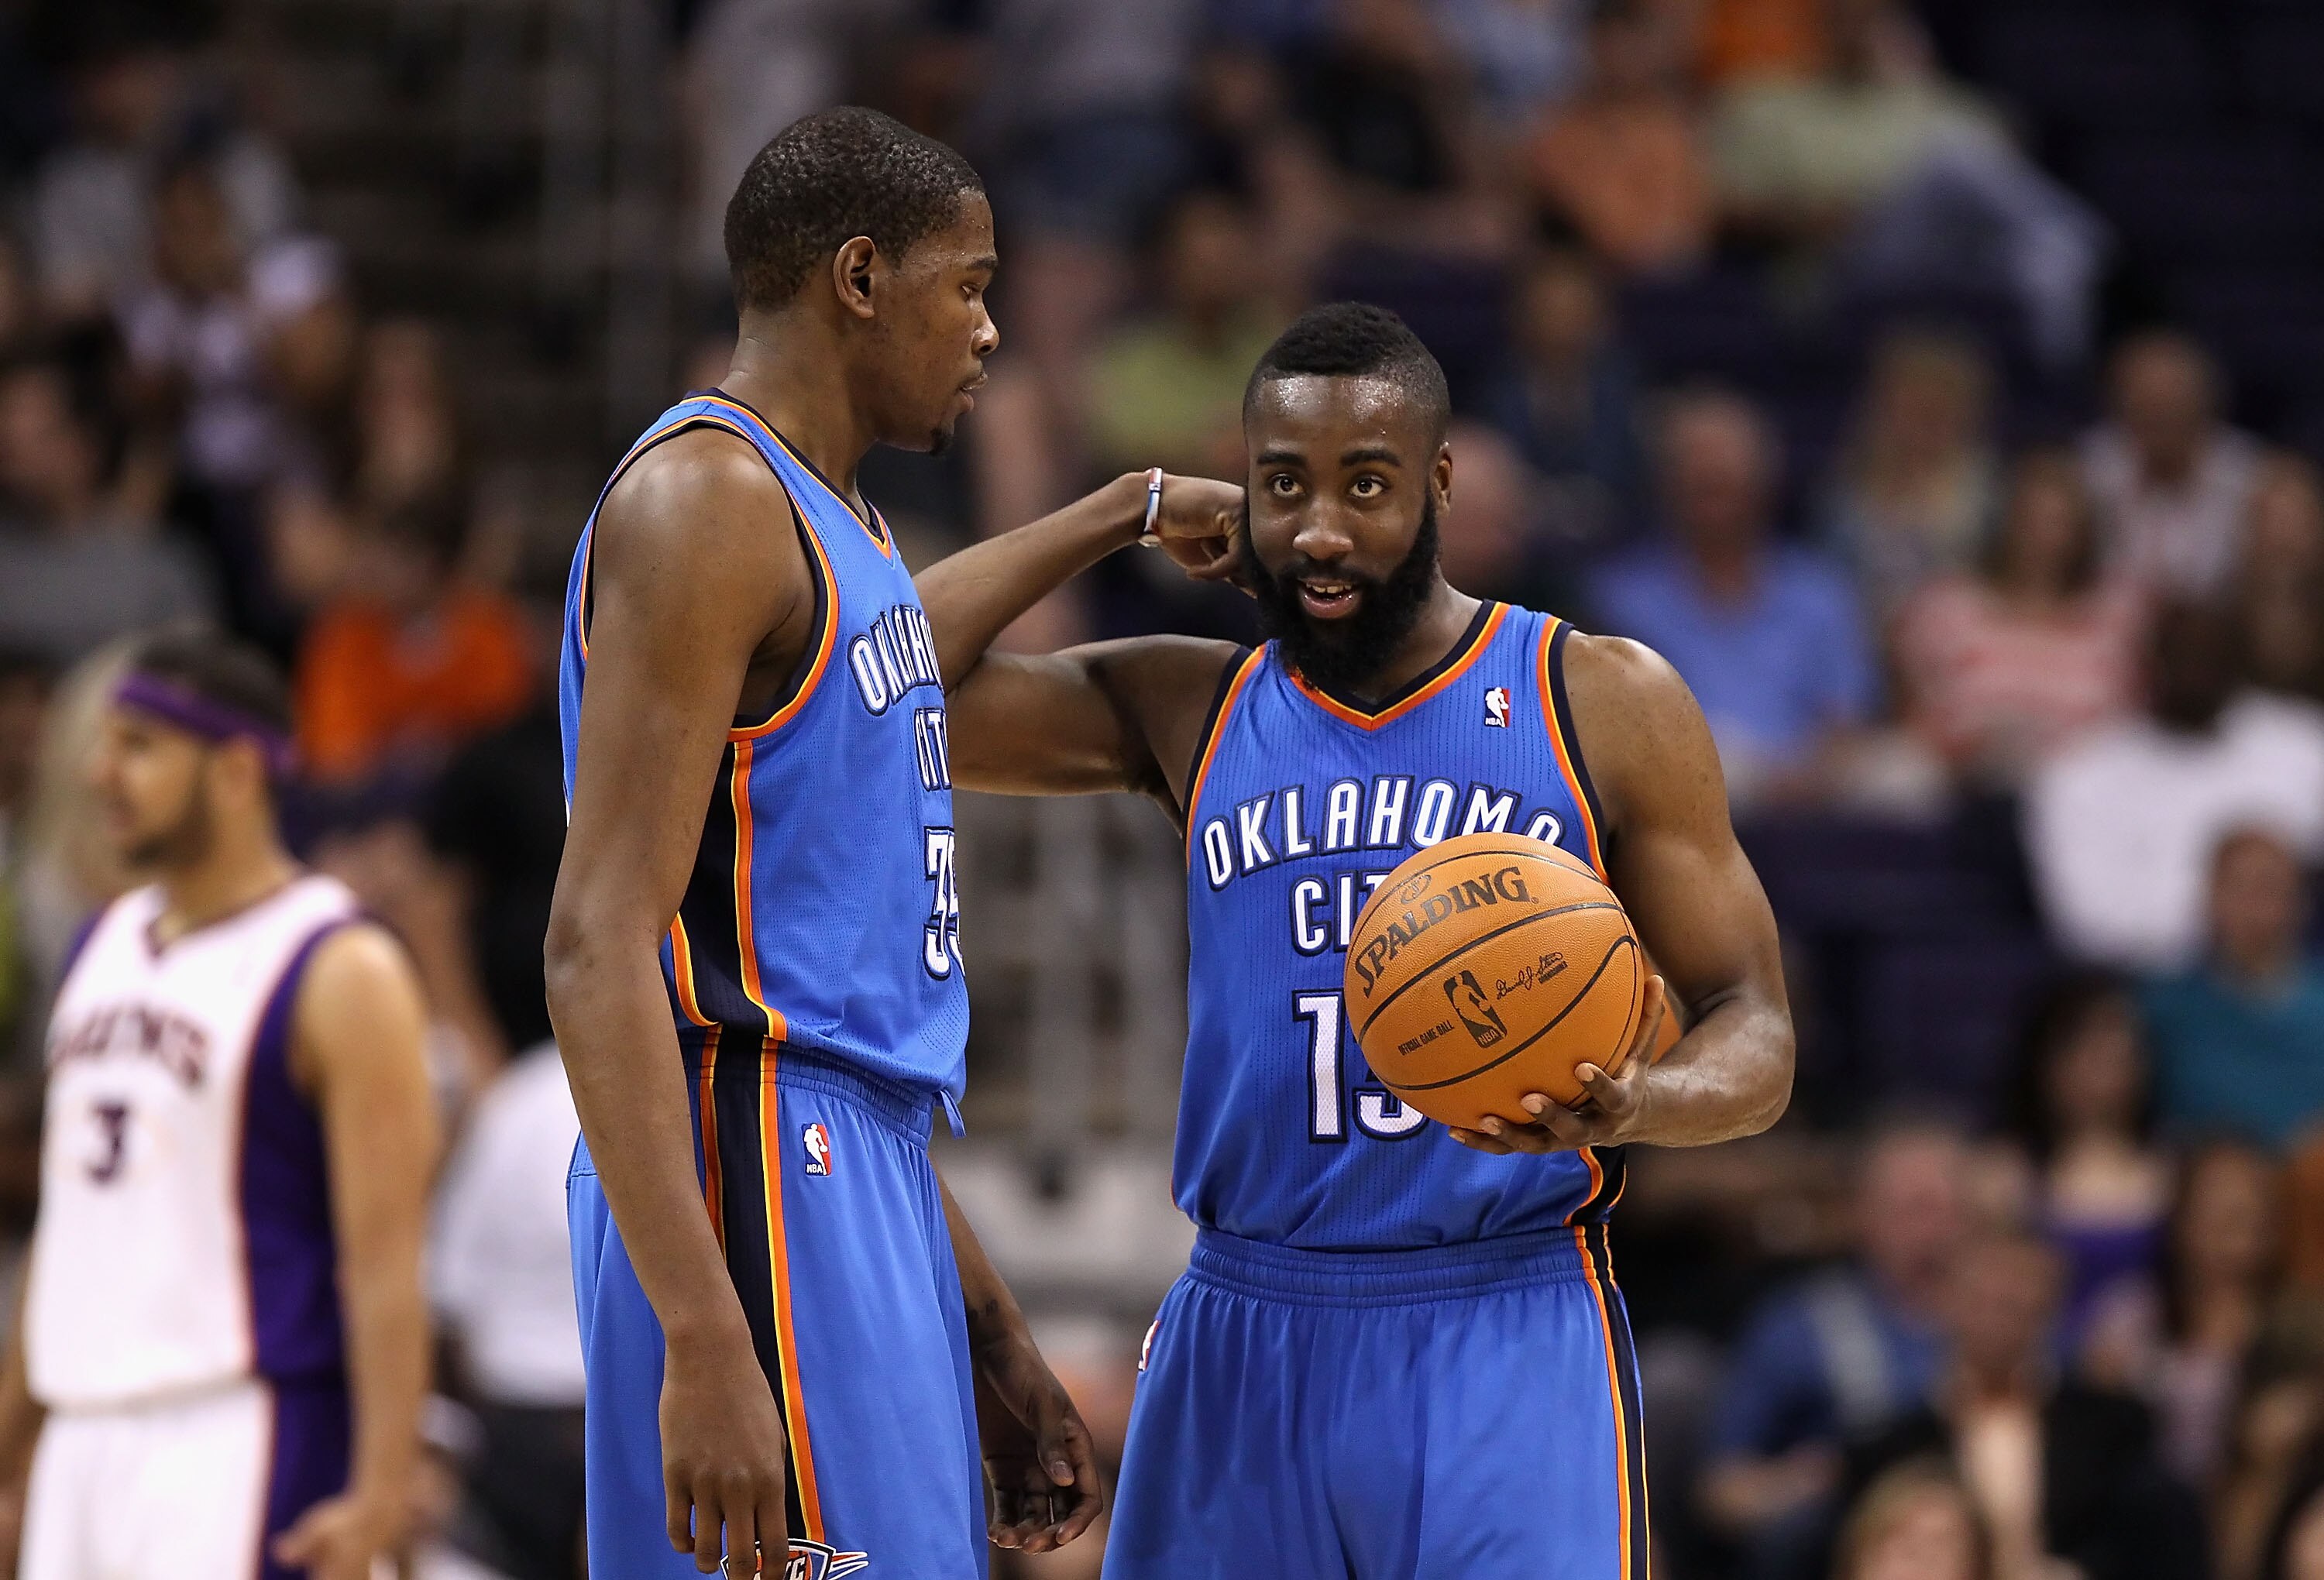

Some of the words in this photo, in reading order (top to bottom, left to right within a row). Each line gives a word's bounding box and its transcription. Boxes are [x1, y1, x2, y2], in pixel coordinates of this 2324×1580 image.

[847, 604, 945, 717] OKLAHO
[913, 707, 952, 792] CIT
[1291, 868, 1394, 957] CI
[1354, 867, 1531, 999] SPALDING
[1397, 1036, 1423, 1056] OFFICIAL
[1418, 1027, 1439, 1045] GAME
[1435, 1019, 1456, 1036] BALL
[1474, 1029, 1499, 1046] NBA
[806, 1163, 823, 1173] NBA
